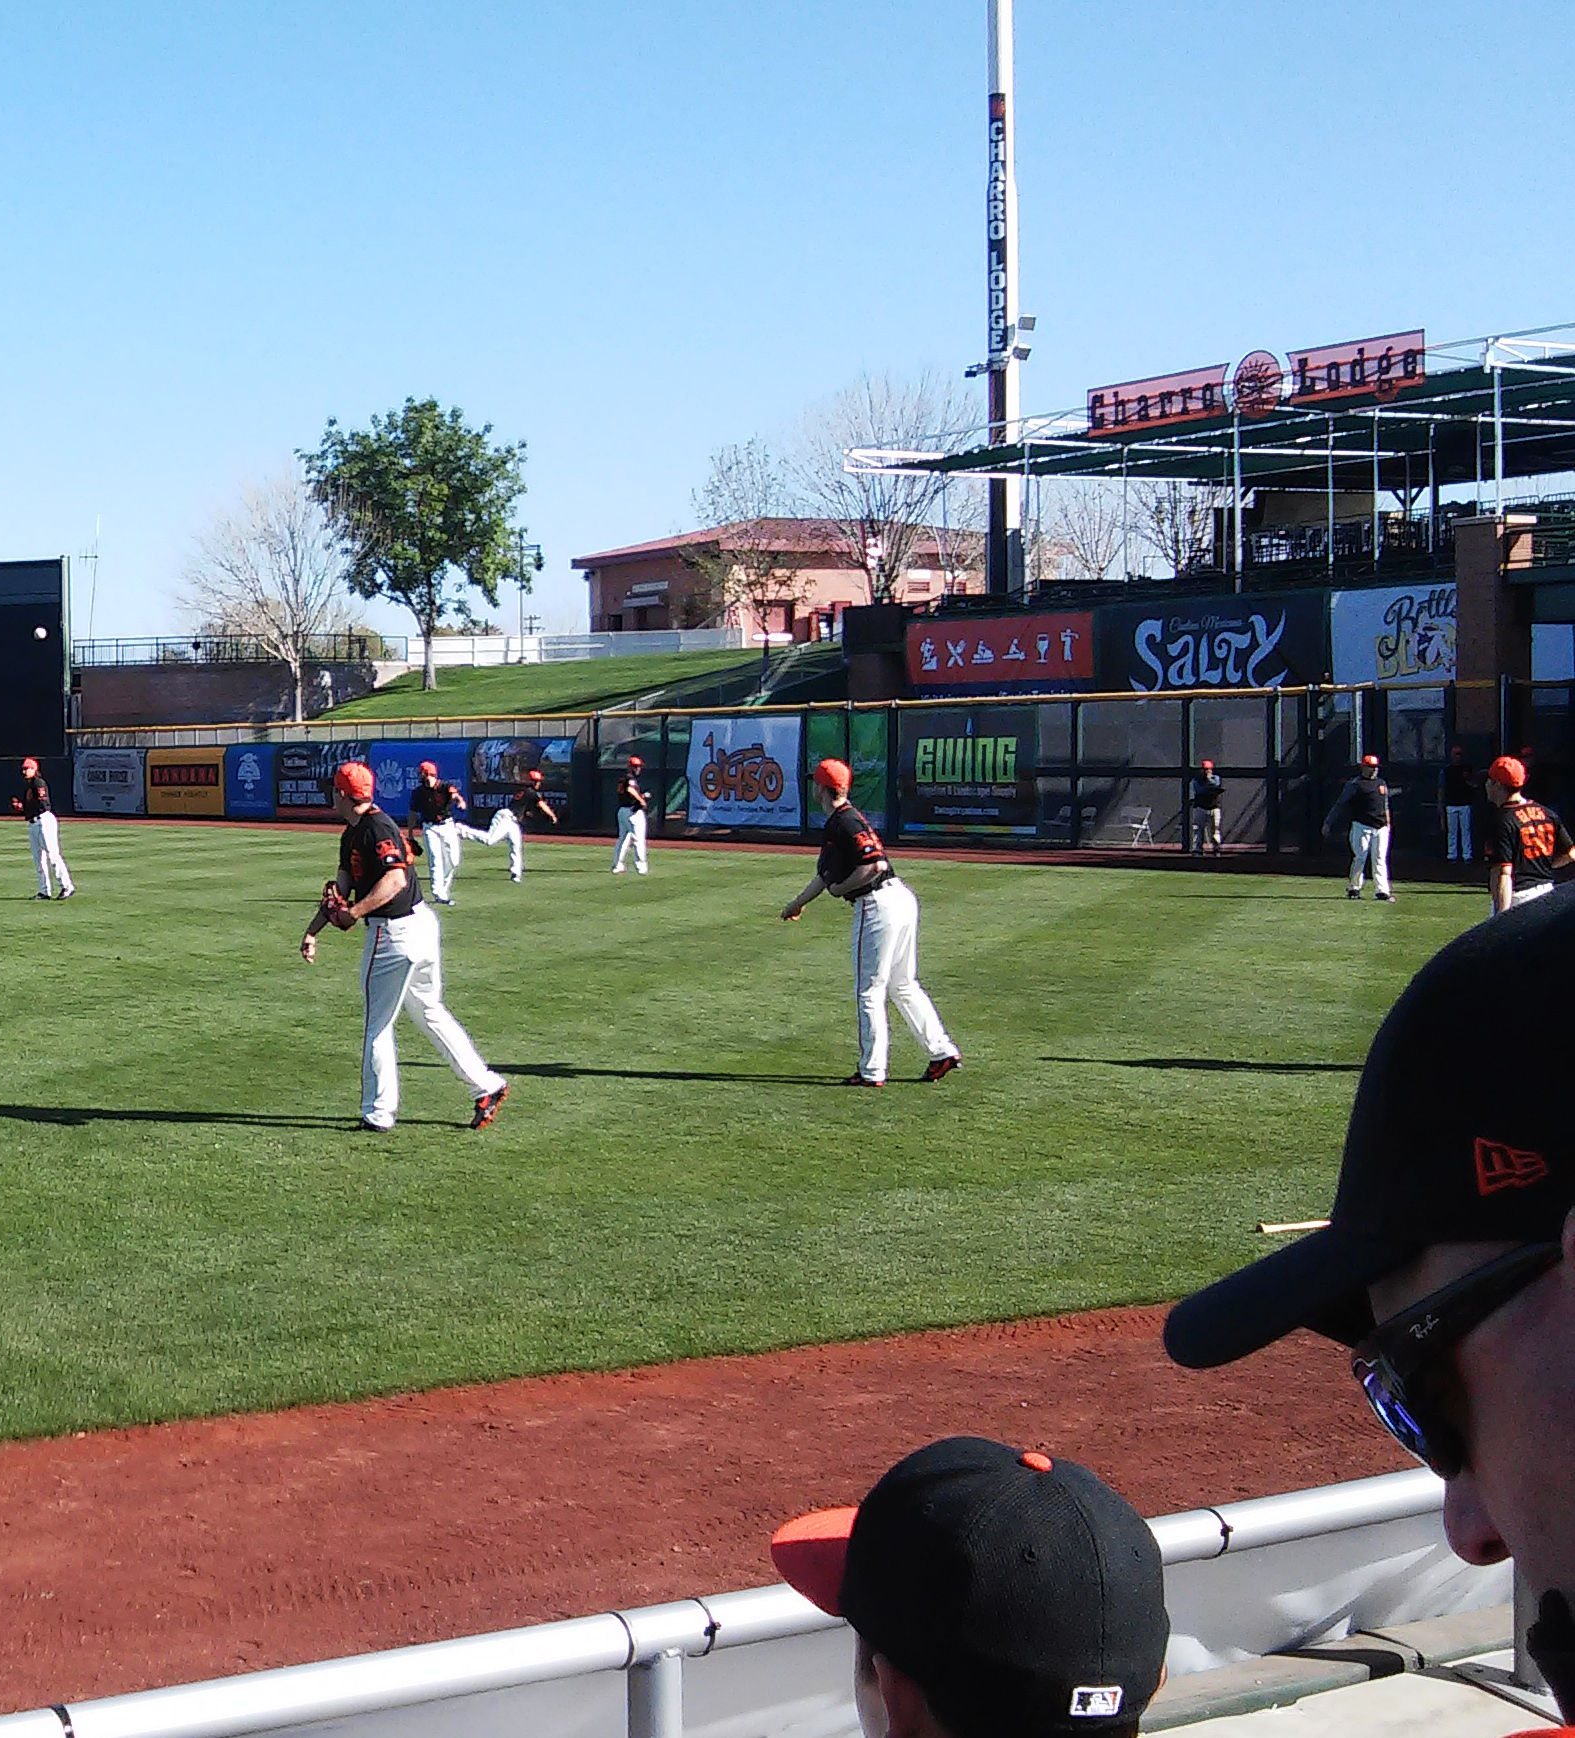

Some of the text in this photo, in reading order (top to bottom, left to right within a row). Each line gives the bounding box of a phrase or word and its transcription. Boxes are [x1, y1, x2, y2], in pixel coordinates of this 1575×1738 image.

[988, 122, 1006, 350] CHARRO LODGE
[1090, 346, 1420, 430] Charro Lodge
[154, 768, 216, 784] BANDERA
[700, 761, 783, 802] OHSO
[915, 736, 1017, 782] EWING
